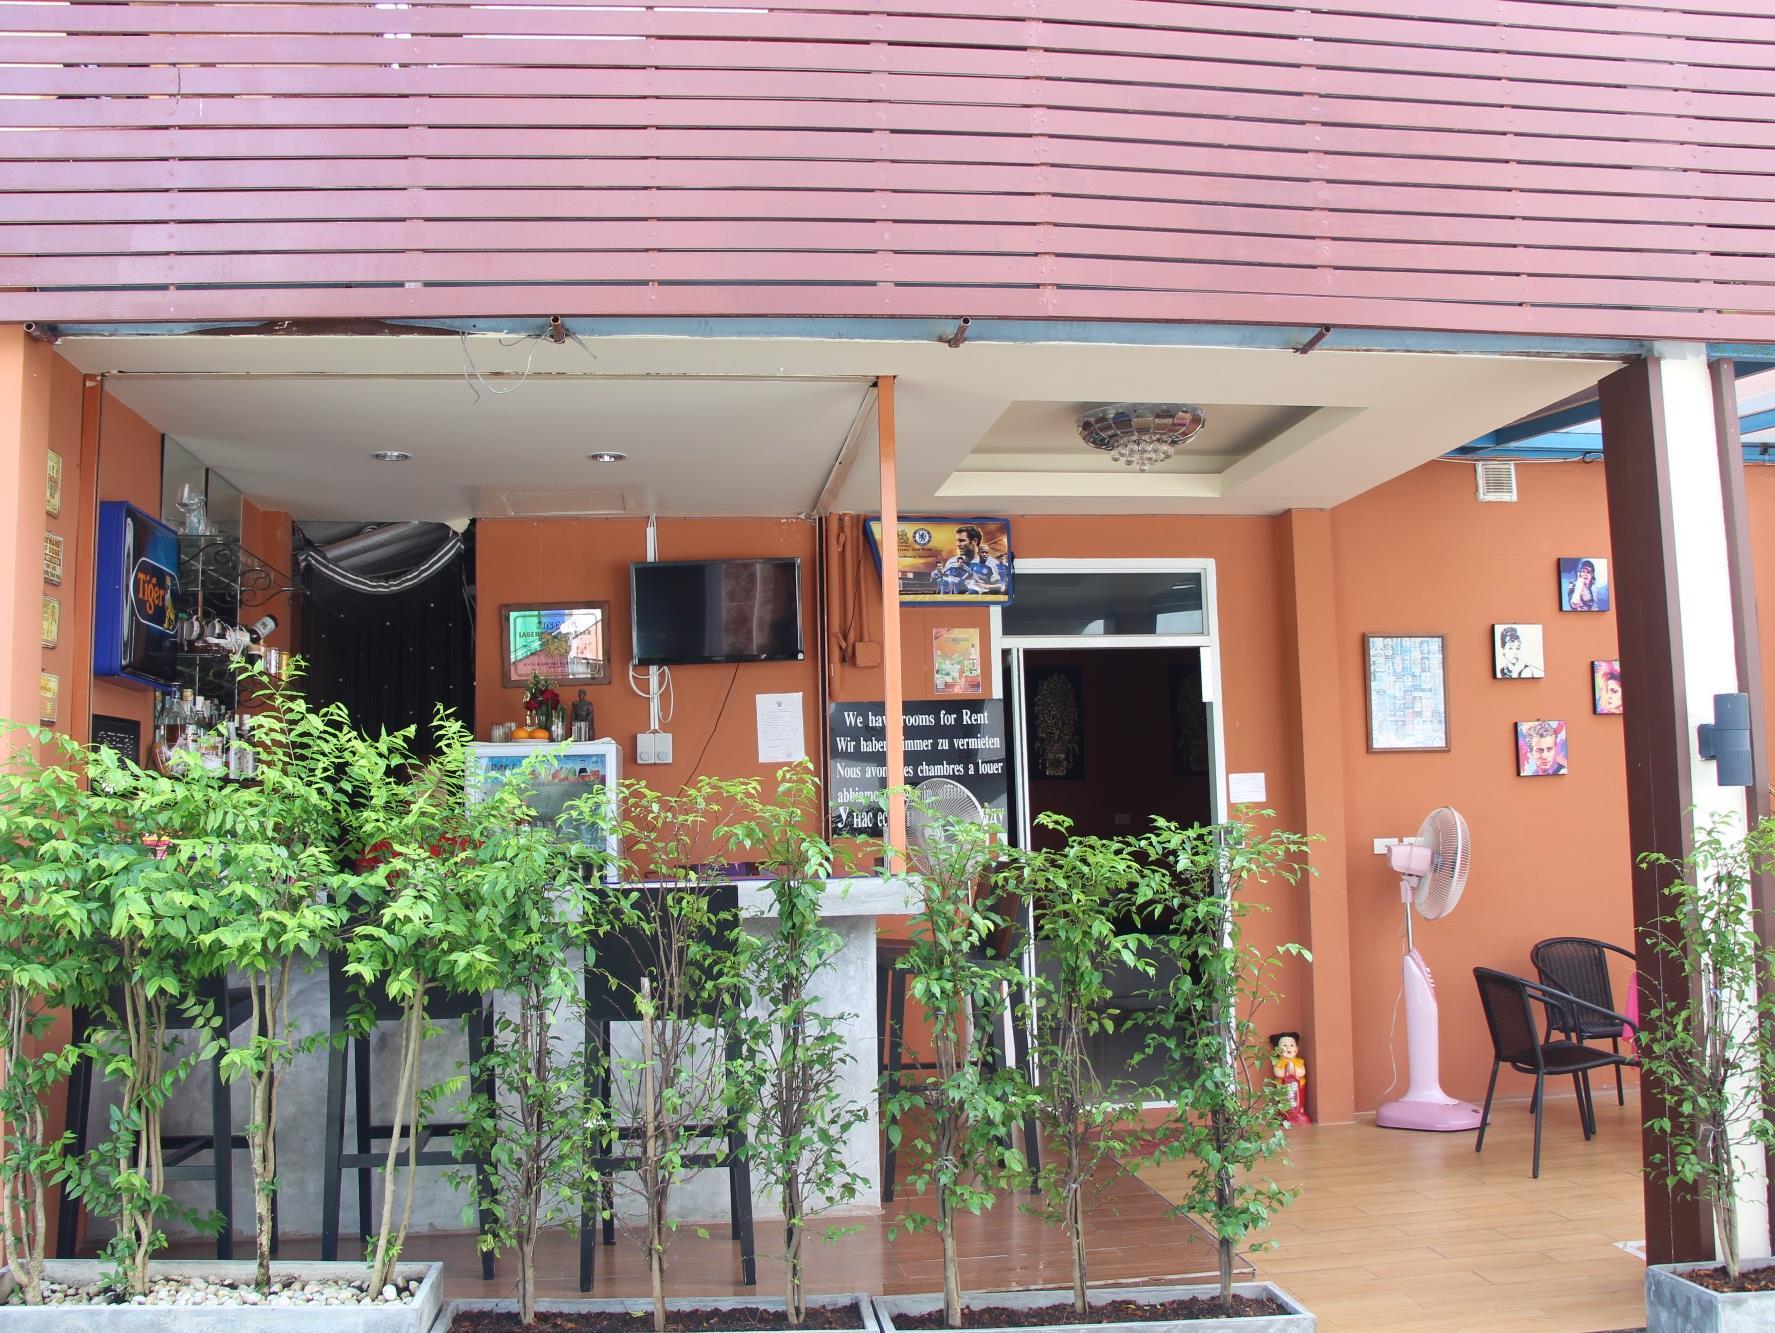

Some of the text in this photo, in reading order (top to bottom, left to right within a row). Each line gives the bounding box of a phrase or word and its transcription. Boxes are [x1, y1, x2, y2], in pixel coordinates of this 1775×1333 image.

[137, 571, 165, 614] Tiger
[843, 709, 989, 727] We hav rooms for Rent
[836, 736, 856, 753] Wir
[901, 735, 933, 751] immer
[937, 738, 950, 750] zu
[953, 733, 1000, 750] vermieten
[836, 759, 1004, 778] Nous avon es chambres a louer
